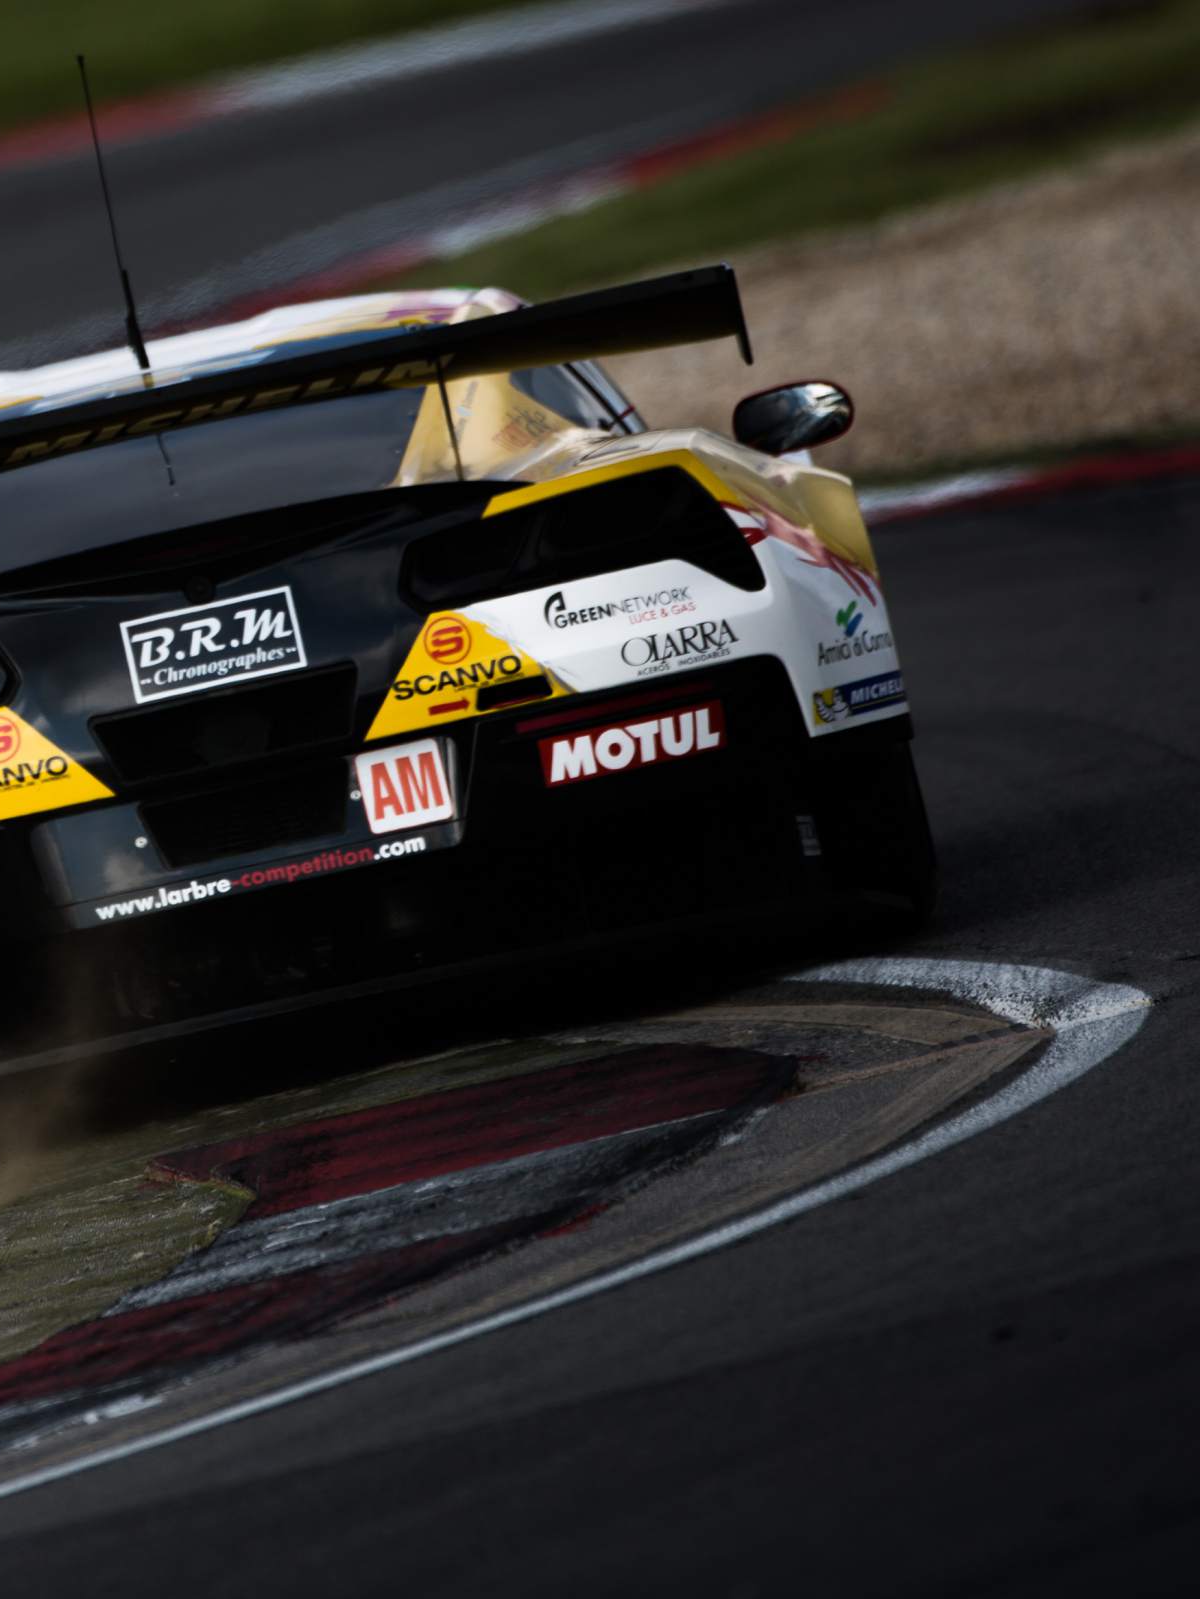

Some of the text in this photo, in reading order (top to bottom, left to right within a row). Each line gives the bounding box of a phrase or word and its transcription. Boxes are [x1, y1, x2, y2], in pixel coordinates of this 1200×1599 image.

[629, 602, 696, 625] LUCE & GAS
[621, 619, 739, 666] OLARRA
[677, 648, 731, 666] INOXIDABLES
[818, 637, 851, 666] Amici
[392, 655, 521, 700] SCANVO
[851, 679, 903, 704] MICHEL
[551, 708, 720, 782] MOTUL
[370, 751, 444, 820] AM
[95, 836, 426, 920] www.larbre-competition.com
